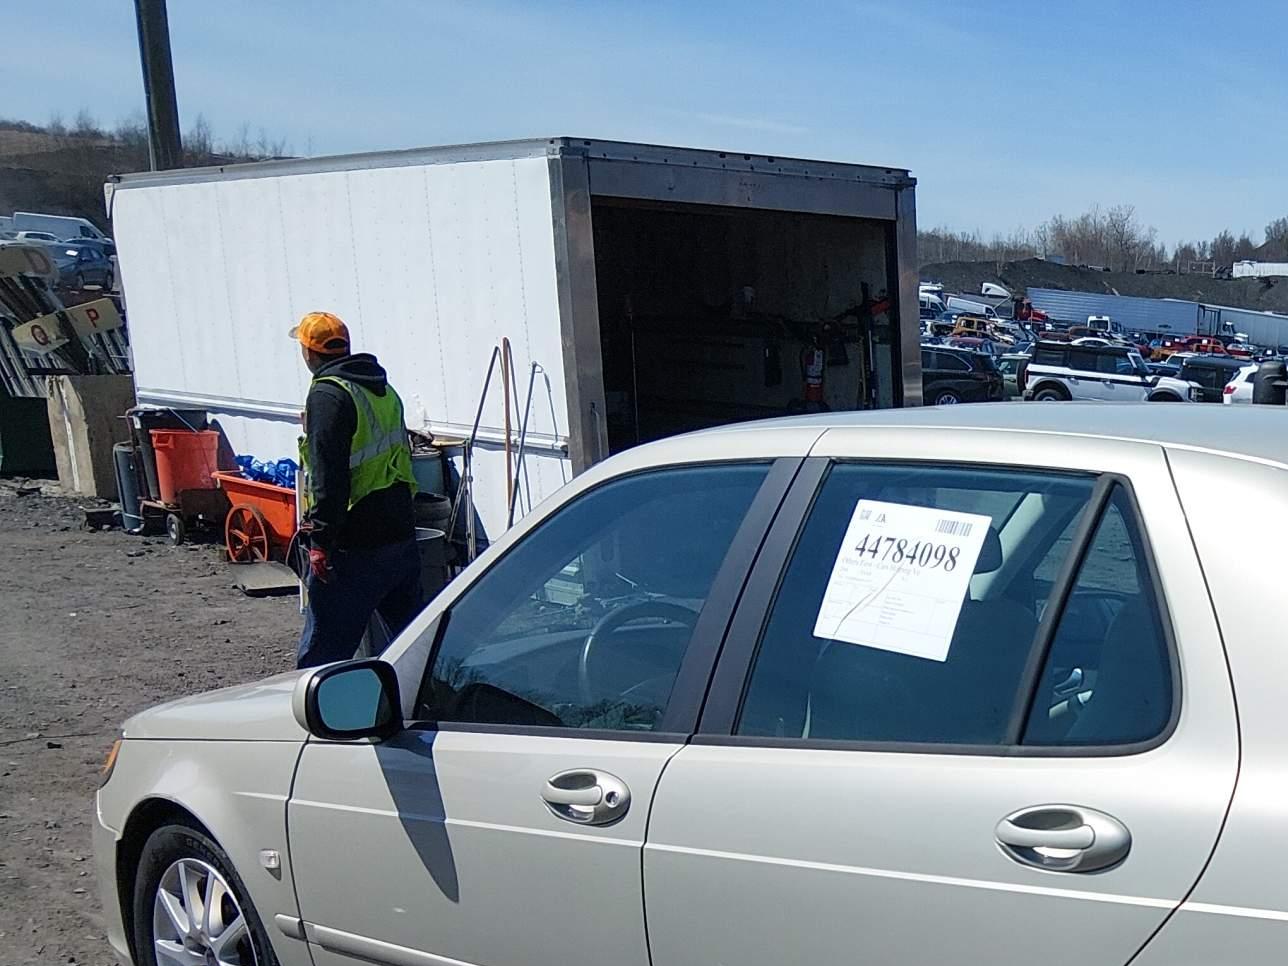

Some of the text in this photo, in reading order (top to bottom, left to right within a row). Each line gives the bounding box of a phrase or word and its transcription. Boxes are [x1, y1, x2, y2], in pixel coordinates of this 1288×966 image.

[85, 307, 100, 328] P
[30, 324, 51, 346] Q
[855, 533, 961, 572] 44784098
